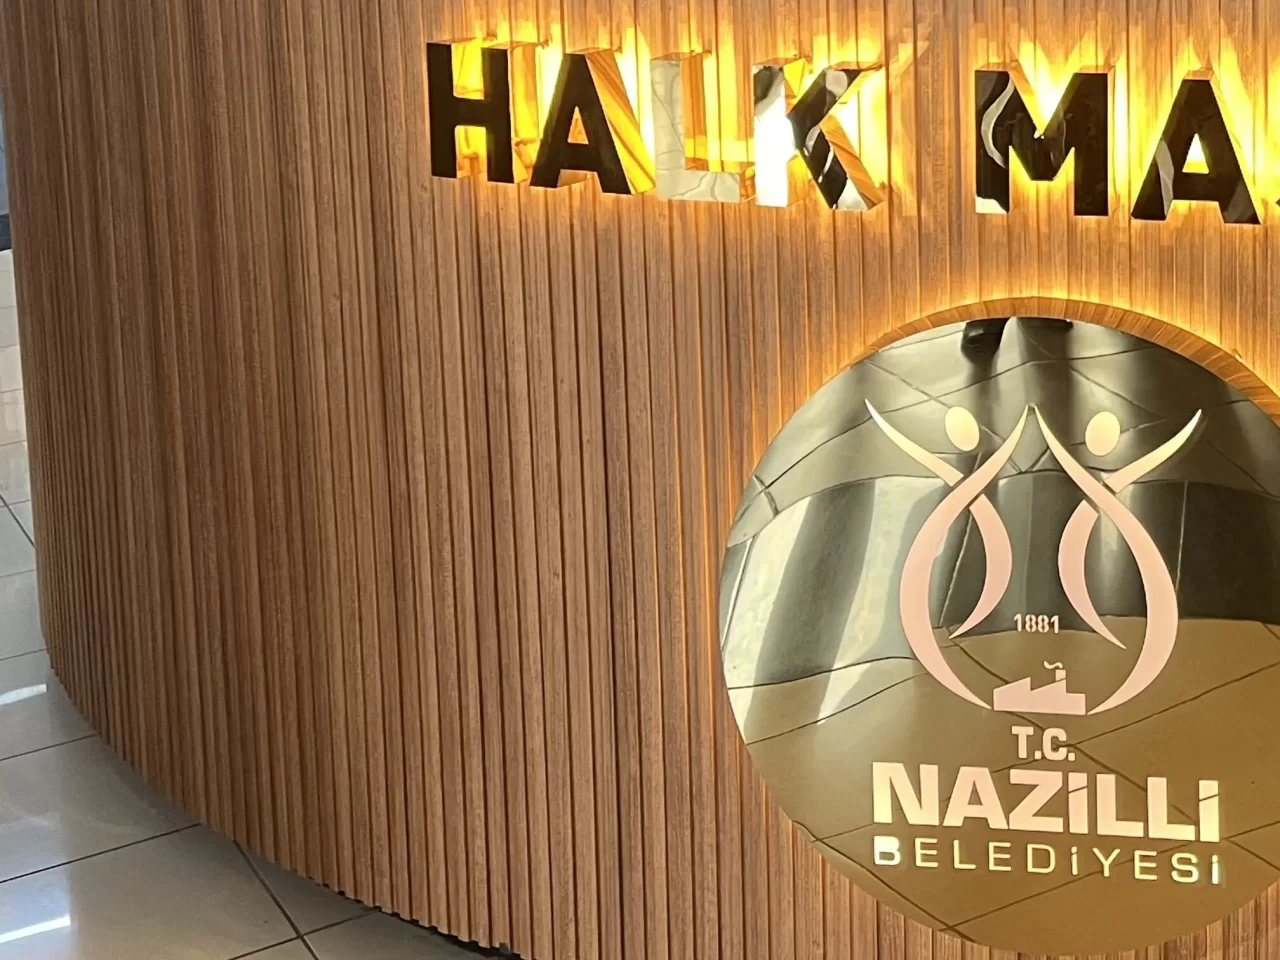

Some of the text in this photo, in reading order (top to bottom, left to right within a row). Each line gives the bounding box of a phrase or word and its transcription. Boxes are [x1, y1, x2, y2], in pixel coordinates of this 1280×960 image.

[426, 38, 884, 211] HALK
[1013, 613, 1060, 635] 1881
[1011, 725, 1076, 762] T.C.
